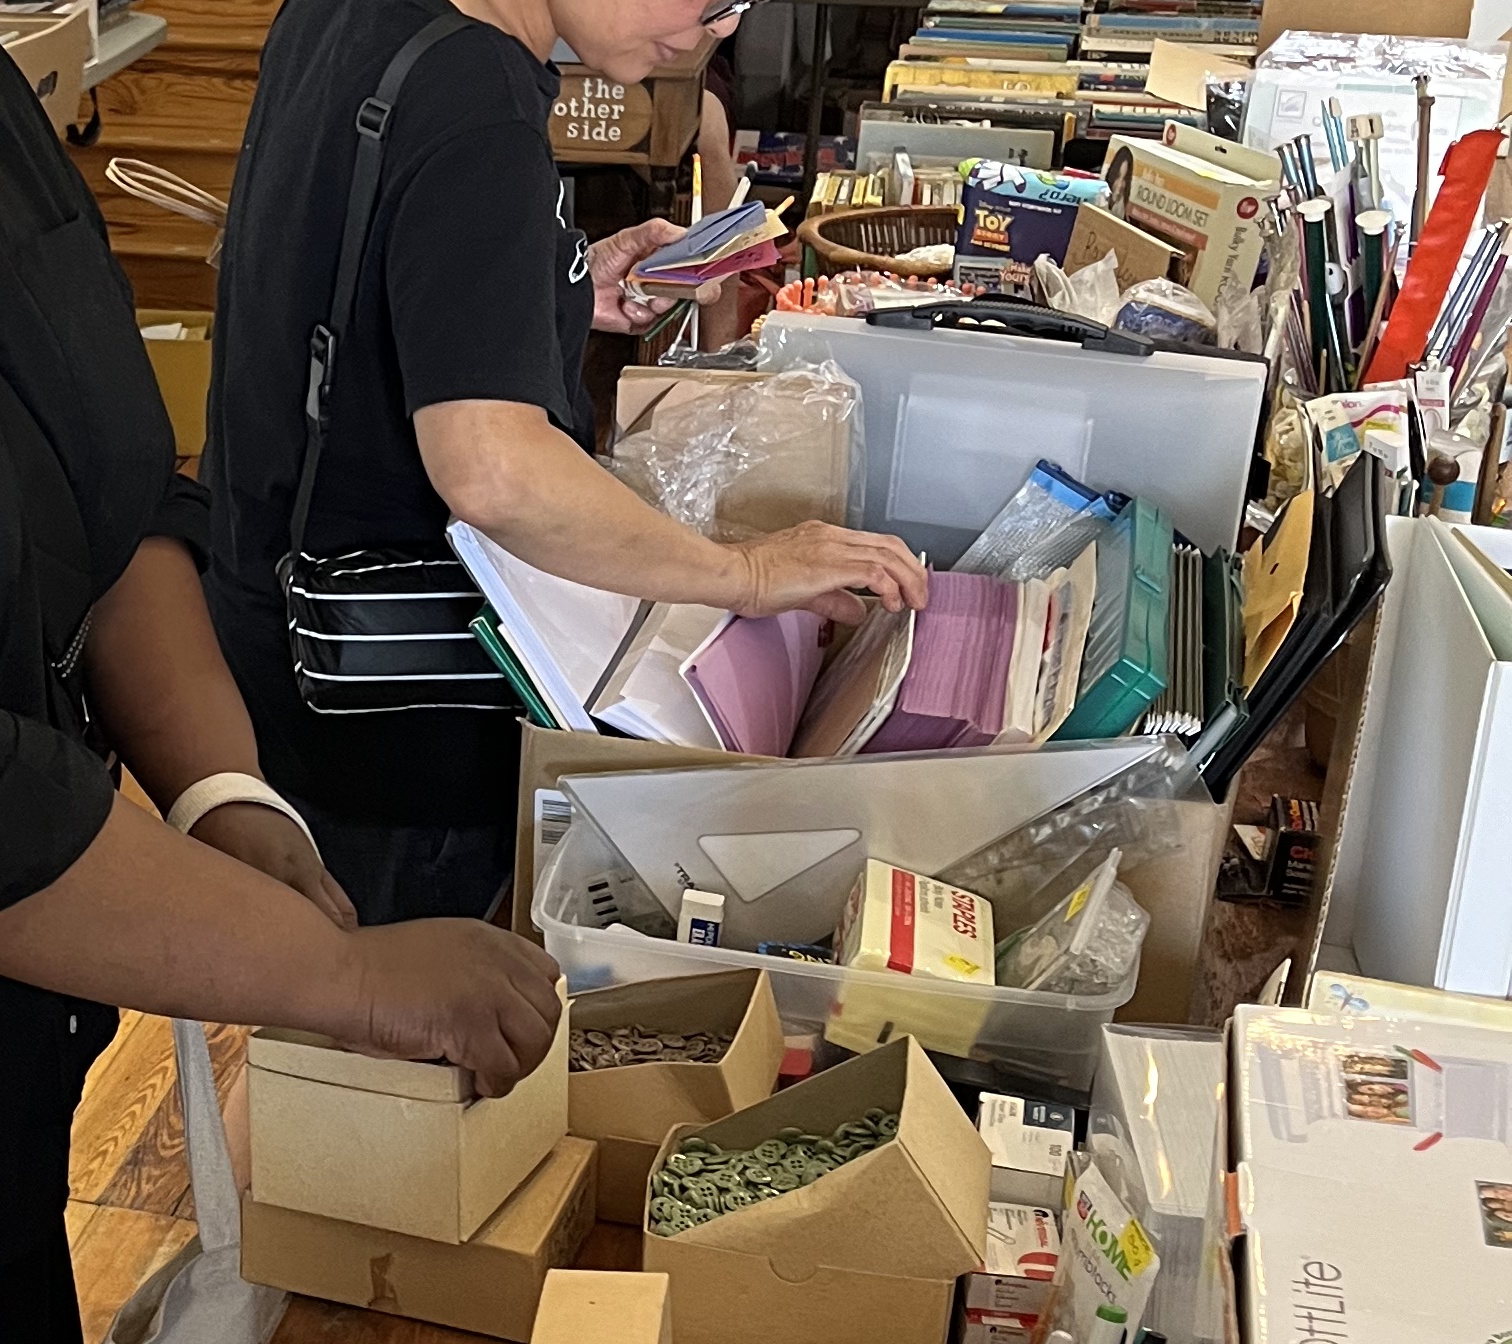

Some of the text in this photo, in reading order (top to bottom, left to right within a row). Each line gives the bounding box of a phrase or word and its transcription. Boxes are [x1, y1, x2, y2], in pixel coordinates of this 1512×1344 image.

[583, 77, 625, 101] the
[554, 97, 625, 120] other
[566, 120, 622, 142] side
[1137, 184, 1167, 210] ROUND
[1165, 197, 1193, 222] LOOM
[1192, 209, 1210, 228] SET
[974, 207, 1015, 232] TOY
[951, 890, 977, 939] STAPLES
